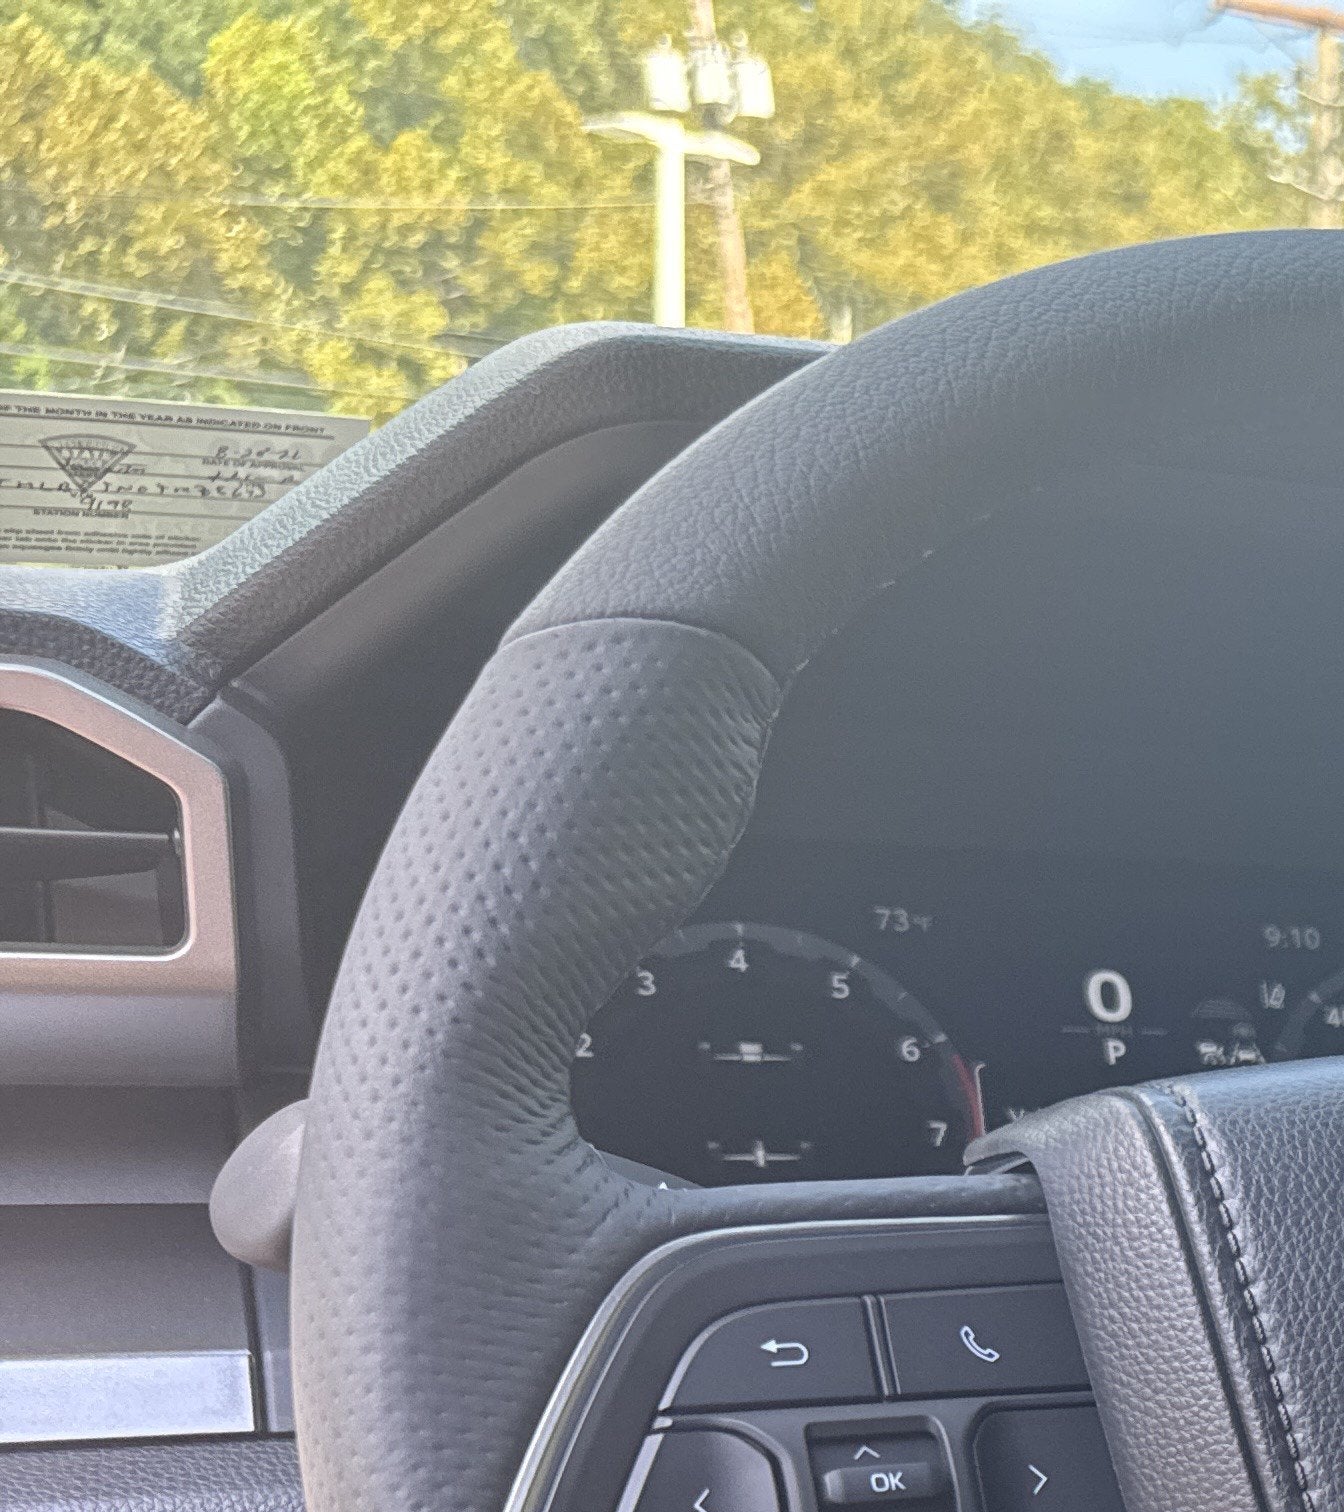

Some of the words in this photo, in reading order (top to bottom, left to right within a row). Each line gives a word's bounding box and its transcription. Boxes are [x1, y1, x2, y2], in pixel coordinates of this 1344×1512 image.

[729, 950, 748, 972] 4
[637, 971, 657, 996] 3
[831, 972, 850, 999] 5
[1084, 968, 1132, 1023] 0
[576, 1034, 594, 1058] 2
[901, 1037, 920, 1062] 6
[1103, 1038, 1127, 1066] P
[929, 1121, 947, 1147] 7
[869, 1471, 906, 1494] OK
